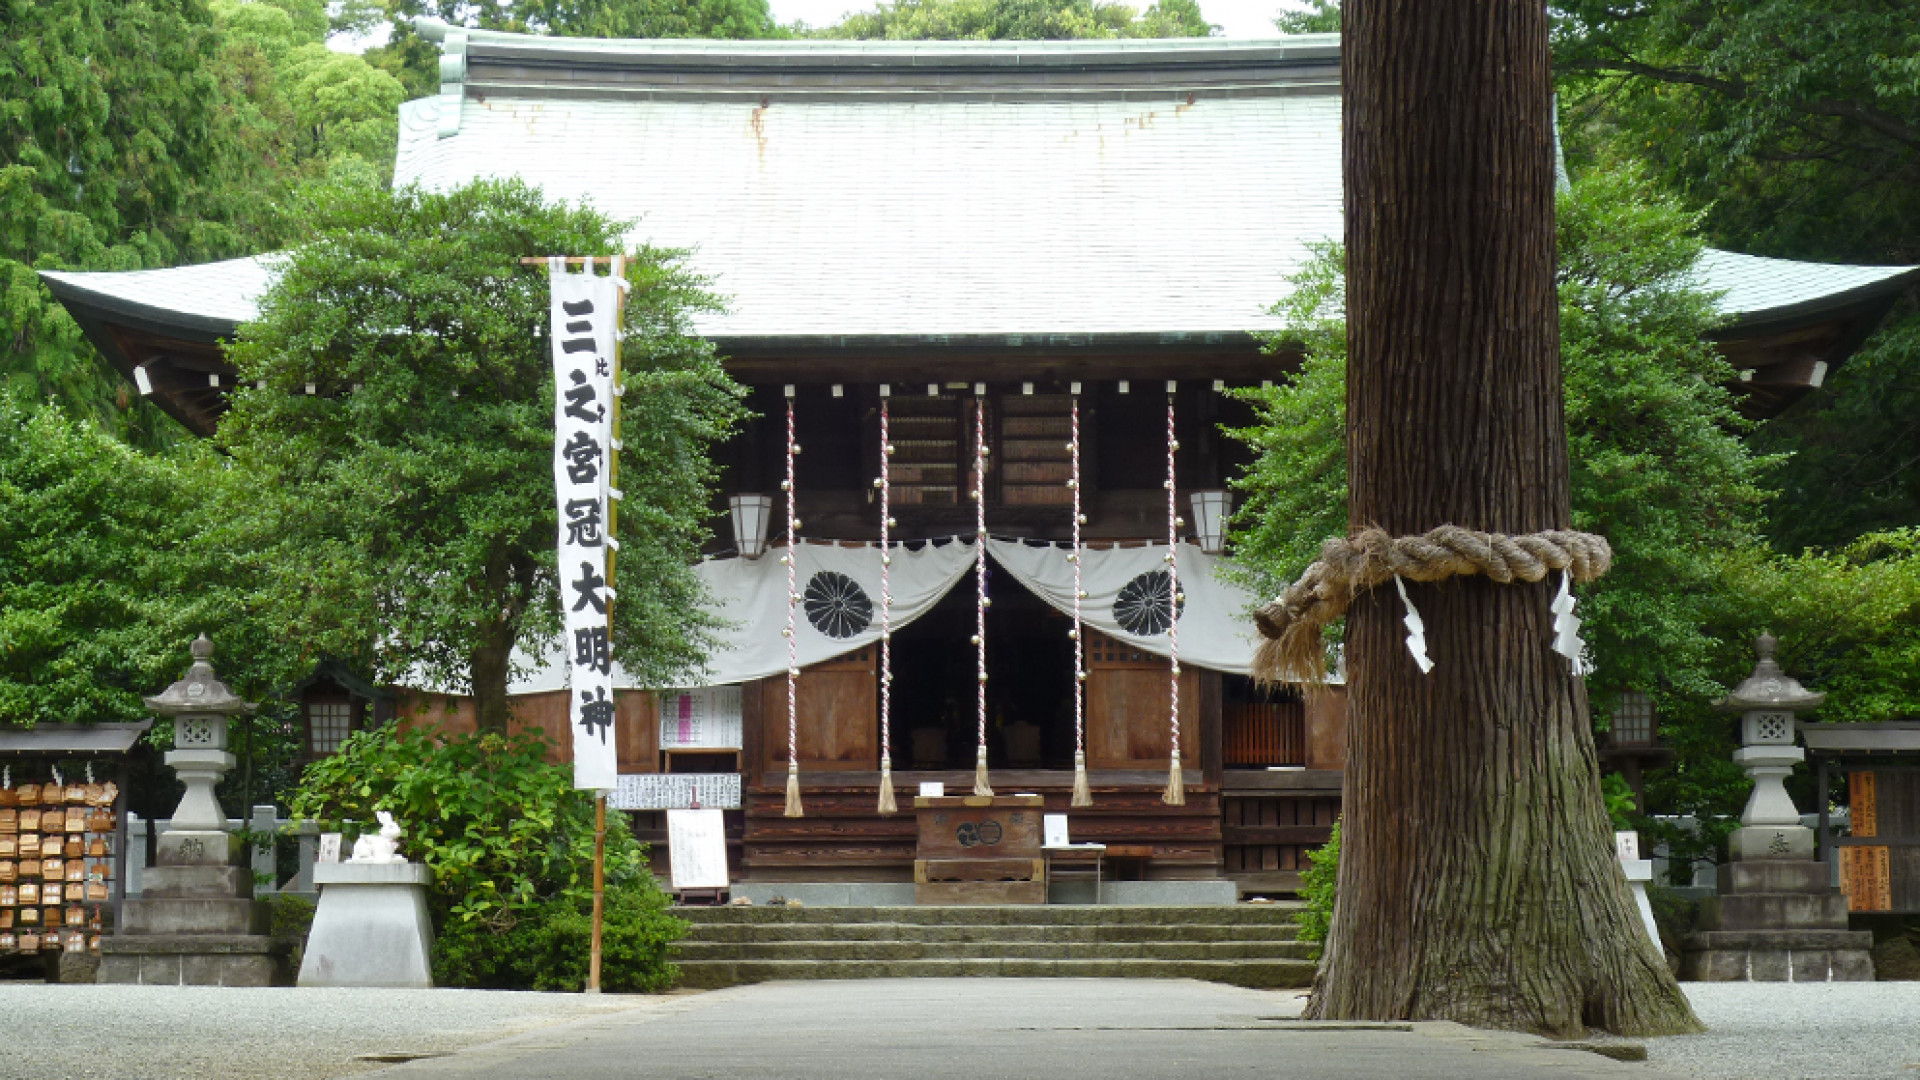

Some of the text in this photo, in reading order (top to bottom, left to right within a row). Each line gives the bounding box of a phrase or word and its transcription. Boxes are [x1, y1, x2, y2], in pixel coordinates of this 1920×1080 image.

[561, 299, 613, 746] 三之宮冠大明神
